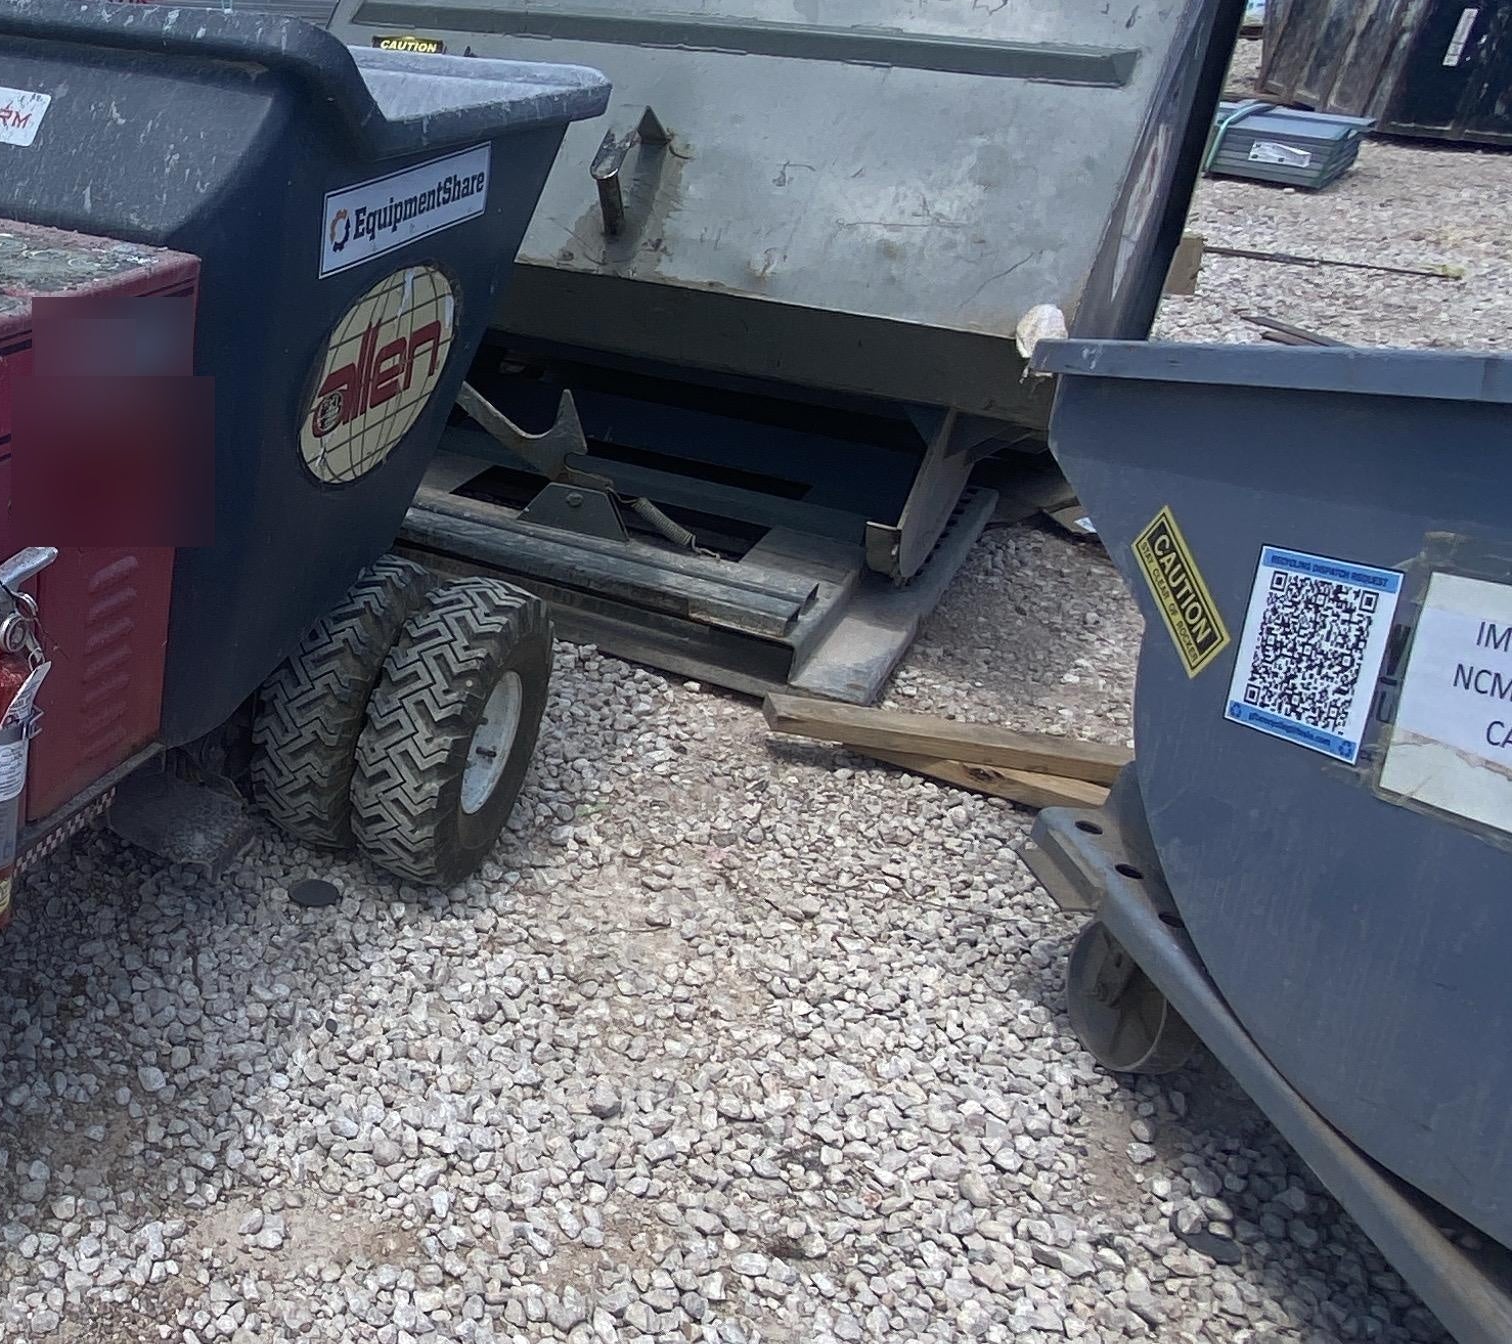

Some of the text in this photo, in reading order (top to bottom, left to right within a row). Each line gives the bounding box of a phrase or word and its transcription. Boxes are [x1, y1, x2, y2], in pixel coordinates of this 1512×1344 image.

[380, 40, 437, 53] CAUTION
[353, 171, 485, 242] EquipmentShare
[312, 320, 442, 438] allen
[1140, 541, 1155, 565] STAY
[1152, 568, 1170, 602] CLEAR
[1154, 534, 1212, 644] CAUTION
